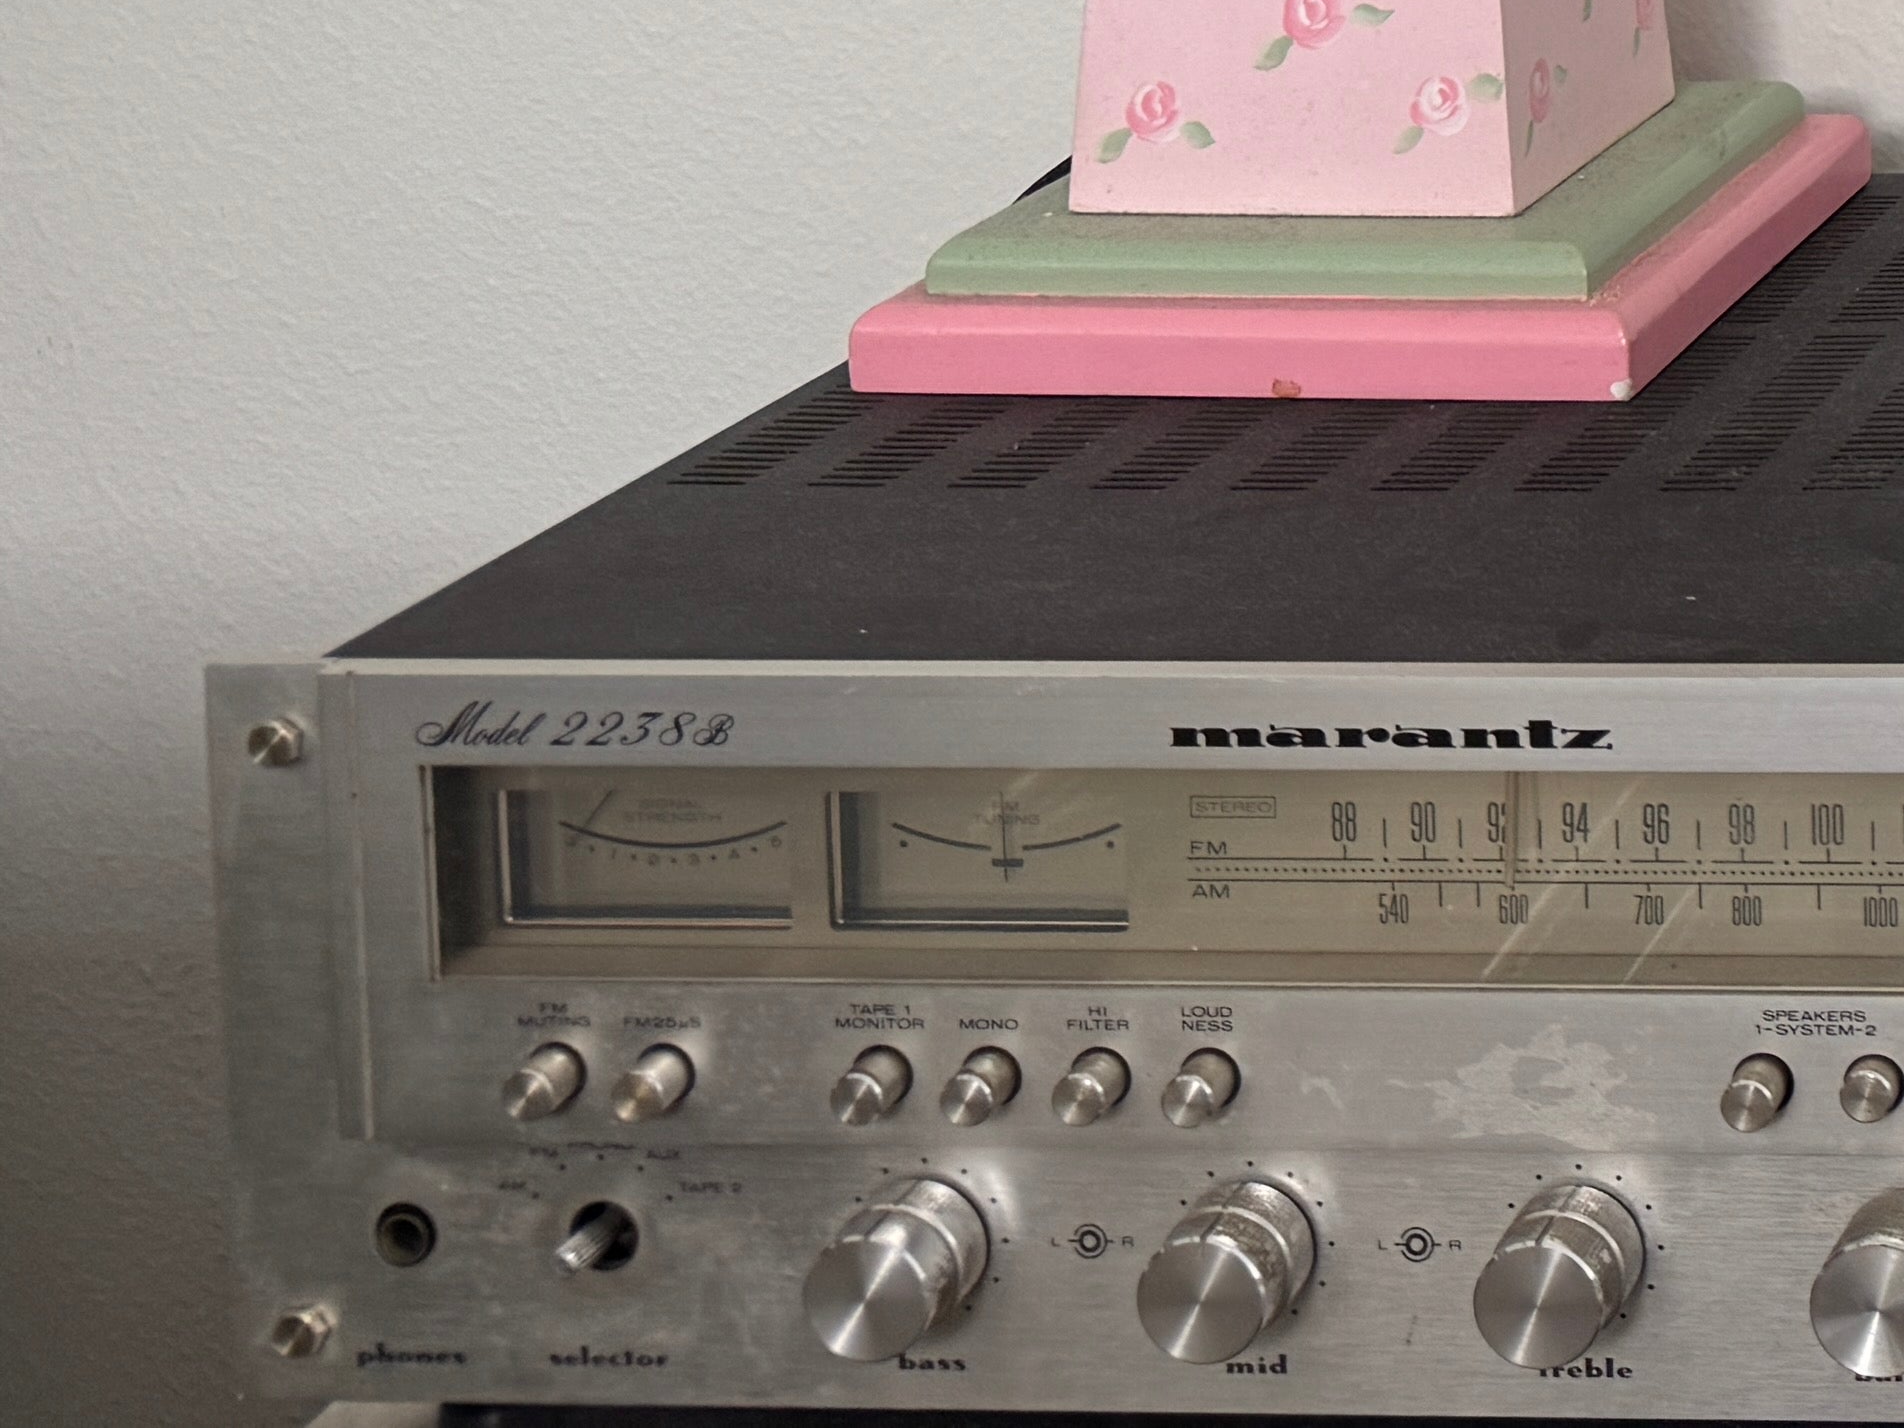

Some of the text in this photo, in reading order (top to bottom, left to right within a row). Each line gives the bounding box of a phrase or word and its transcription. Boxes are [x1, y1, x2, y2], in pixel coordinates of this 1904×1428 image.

[415, 700, 735, 747] Model 2238B
[1170, 720, 1613, 751] marantz
[1193, 800, 1274, 814] STEREO
[1331, 801, 1357, 842] 88
[1410, 801, 1437, 843] 90
[1562, 802, 1590, 844] 94
[1643, 803, 1670, 844] 96
[1728, 803, 1756, 845] 98
[1811, 803, 1844, 846] 100
[1189, 841, 1228, 855] FM
[1191, 884, 1231, 899] AM
[1378, 893, 1409, 924] 540
[1499, 894, 1529, 924] 600
[1633, 895, 1665, 925] 700
[1731, 896, 1762, 926] 800
[1863, 897, 1898, 928] 1000
[848, 1003, 897, 1017] TAPE
[1088, 1006, 1108, 1017] HI
[1181, 1006, 1233, 1018] LOUD
[1762, 1008, 1866, 1023] SPEAKERS
[834, 1017, 925, 1031] MONITOR
[958, 1019, 1019, 1031] MONO
[1066, 1018, 1130, 1032] FILTER
[1181, 1020, 1233, 1033] NESS
[357, 1342, 467, 1367] phones
[549, 1344, 669, 1367] selector
[897, 1352, 967, 1372] bass
[1225, 1353, 1289, 1376] mid
